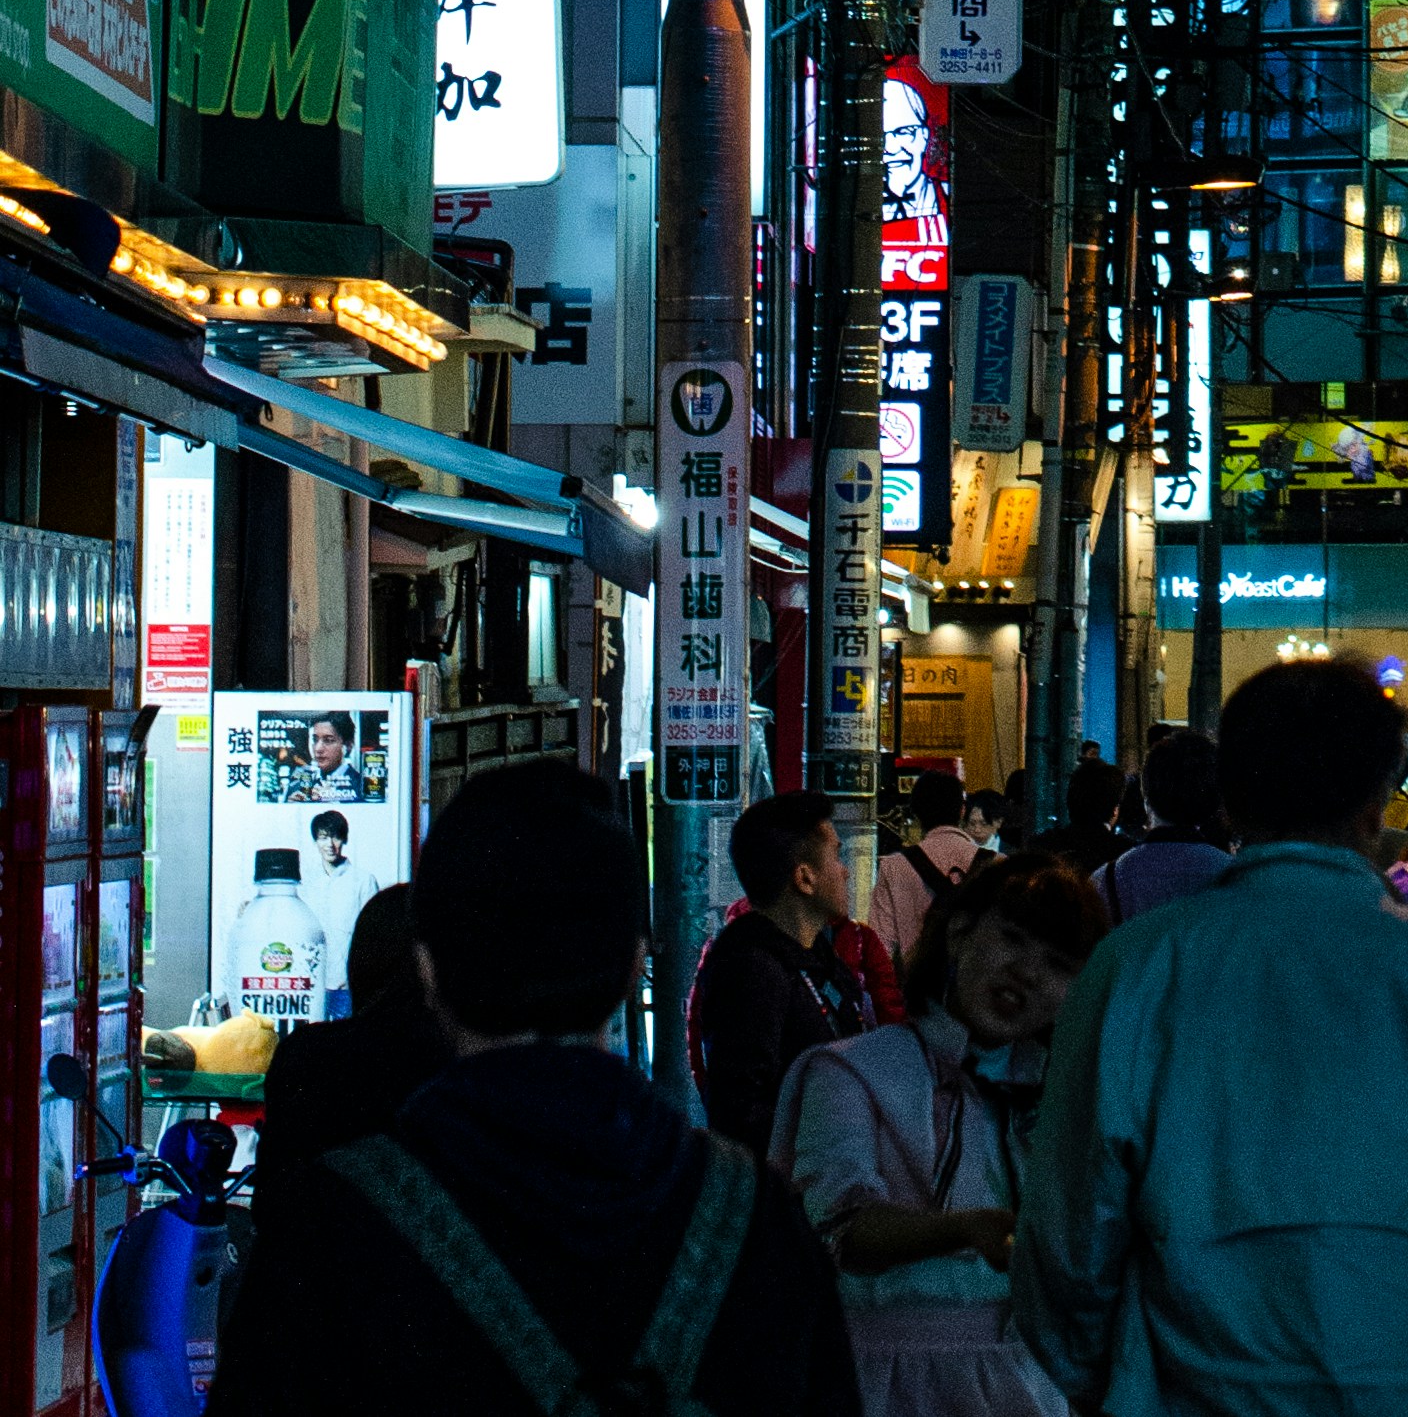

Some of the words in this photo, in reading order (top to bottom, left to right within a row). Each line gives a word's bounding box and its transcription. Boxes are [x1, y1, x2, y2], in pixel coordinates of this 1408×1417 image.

[880, 300, 942, 343] 3F
[679, 450, 725, 683] 福山歯科
[833, 513, 870, 658] 千石電商
[241, 993, 311, 1016] STRONG
